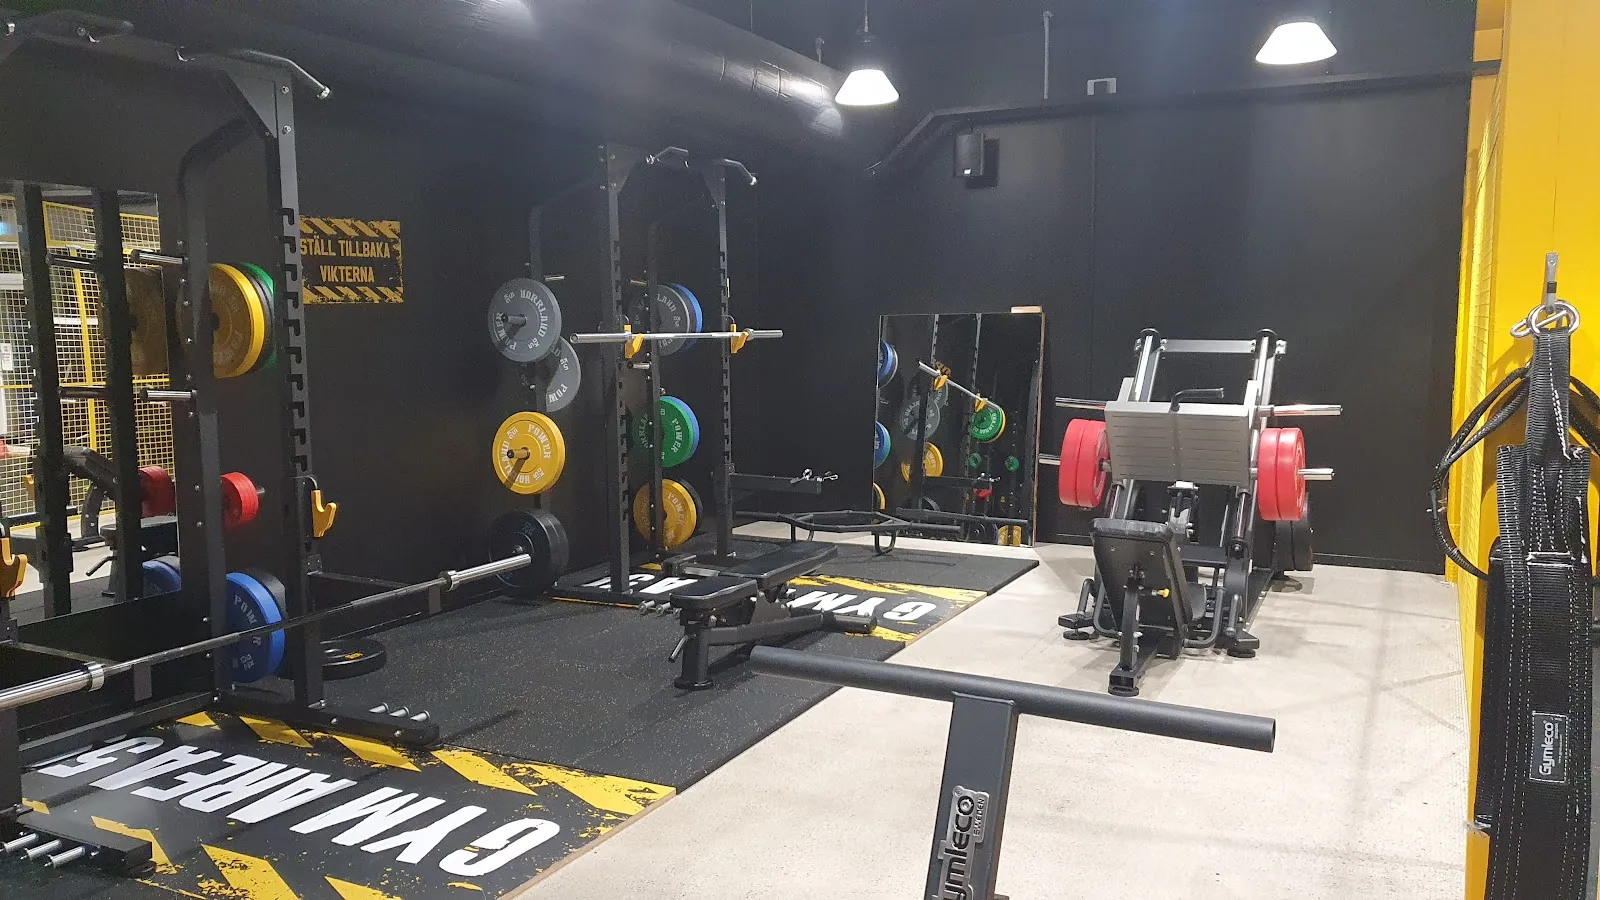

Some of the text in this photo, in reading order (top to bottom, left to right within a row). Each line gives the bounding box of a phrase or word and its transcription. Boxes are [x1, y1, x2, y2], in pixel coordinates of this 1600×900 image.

[300, 235, 390, 258] STÄLL TILLBAKA
[320, 265, 375, 282] VIKTERNA
[548, 383, 568, 403] POW
[528, 424, 551, 459] POWER
[671, 418, 683, 453] POWER
[1539, 722, 1555, 775] Gymleco
[89, 745, 357, 823] AREA
[289, 787, 561, 877] GYM
[973, 798, 985, 837] SWEDEN
[943, 795, 974, 900] ymleco
